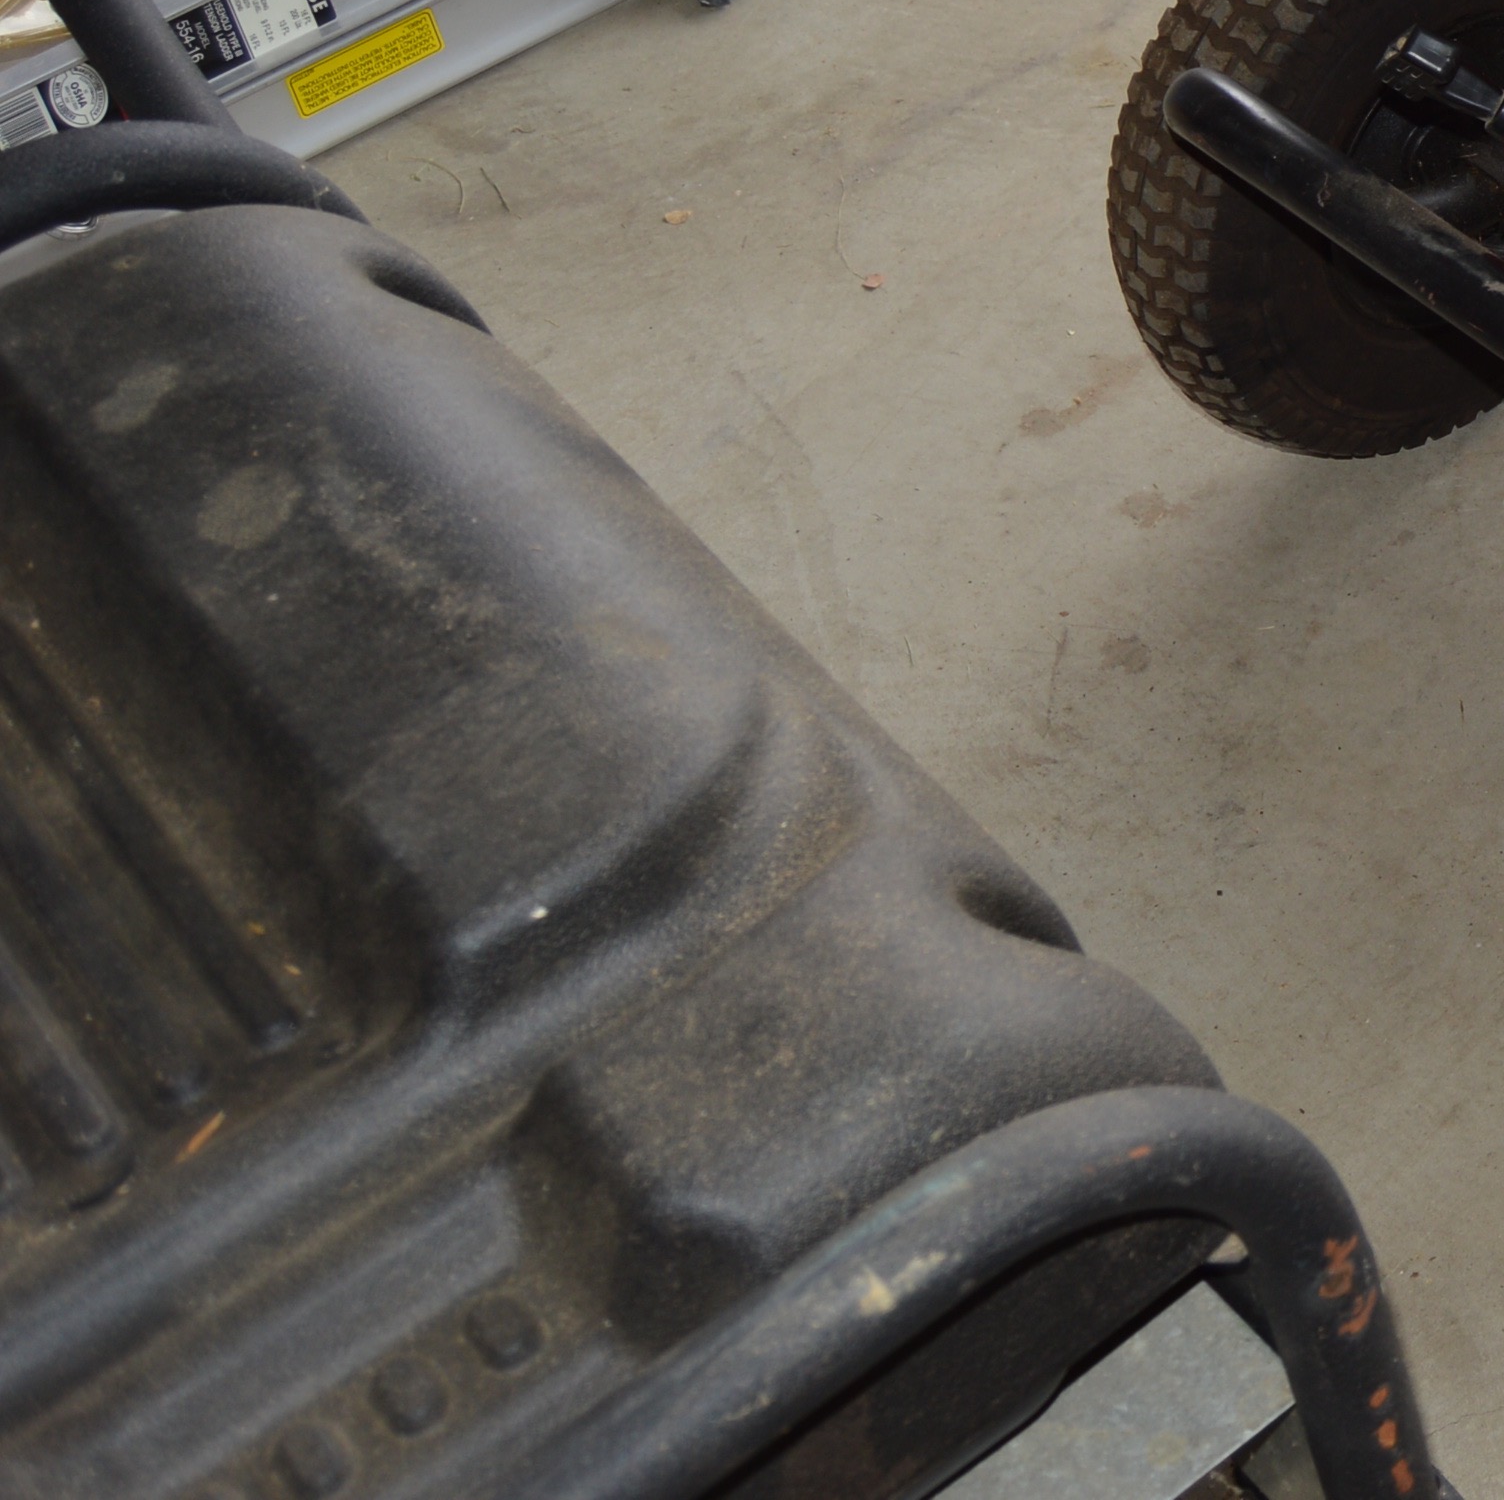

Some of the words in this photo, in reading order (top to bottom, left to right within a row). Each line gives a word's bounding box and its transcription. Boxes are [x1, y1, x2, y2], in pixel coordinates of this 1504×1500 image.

[174, 18, 205, 64] 554-16
[193, 20, 211, 49] MODEL
[214, 31, 235, 61] LADDER
[226, 30, 241, 51] TYPE
[70, 81, 88, 109] OSHA
